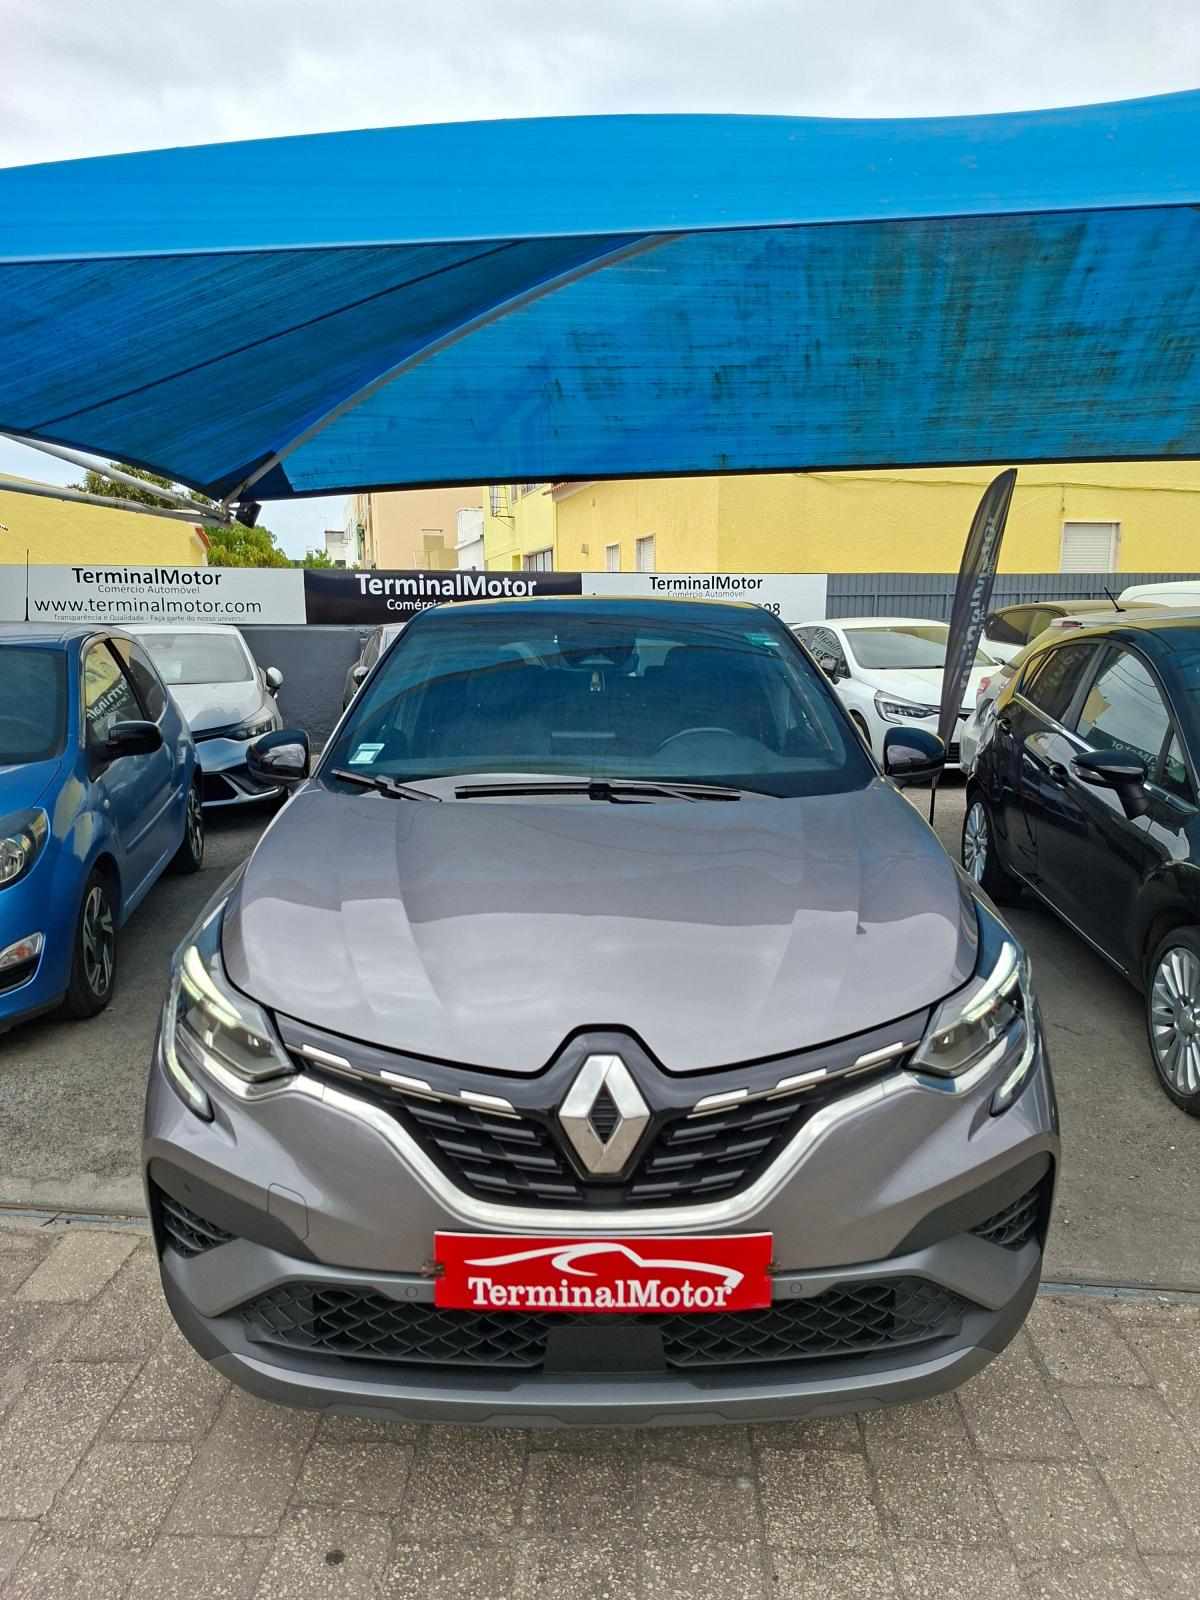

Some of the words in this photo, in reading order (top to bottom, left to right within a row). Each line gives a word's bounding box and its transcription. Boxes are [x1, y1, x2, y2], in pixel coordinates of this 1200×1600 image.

[72, 568, 222, 585] TerminalMotor
[355, 573, 537, 597] TerminalMotor
[649, 576, 763, 591] TerminalMotor
[98, 584, 145, 594] Comércio
[148, 584, 200, 595] Automóvel
[35, 597, 262, 614] www.terminalmotor.com
[386, 598, 442, 611] Comérci
[468, 1278, 732, 1308] TerminalMotor
